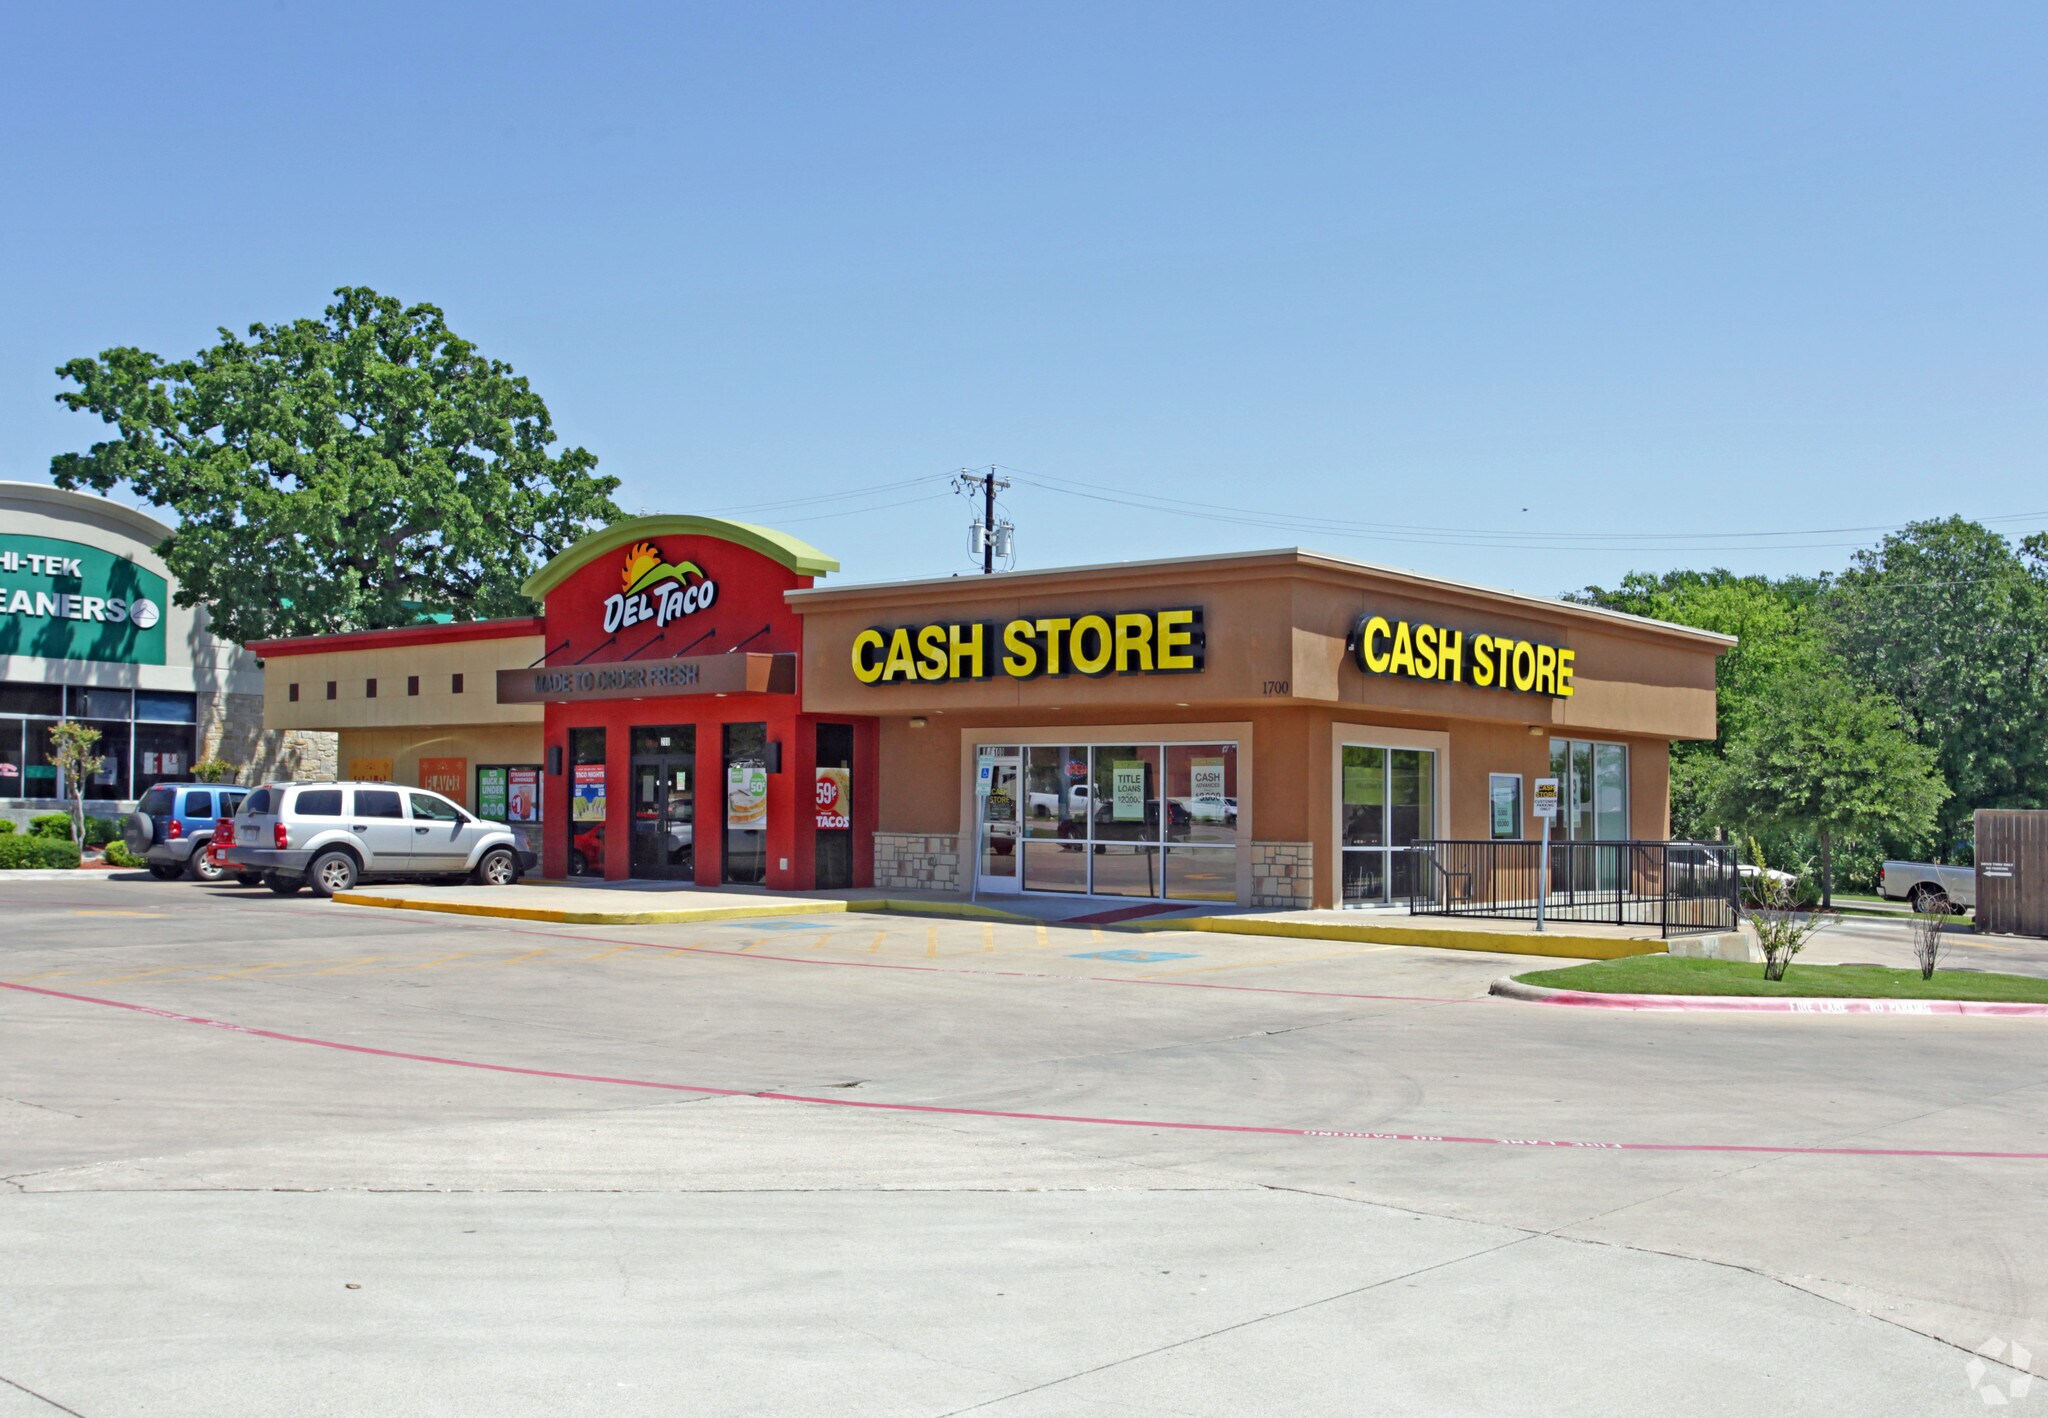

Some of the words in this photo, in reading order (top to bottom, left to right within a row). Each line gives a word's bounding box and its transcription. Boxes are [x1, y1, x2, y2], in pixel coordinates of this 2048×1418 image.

[603, 593, 654, 633] DEL
[653, 581, 714, 627] TACO
[851, 623, 984, 684] CASH
[1002, 610, 1194, 677] STORE
[1363, 615, 1463, 682] CASH
[1472, 633, 1576, 697] STORE
[534, 672, 572, 692] MADE
[575, 671, 594, 691] TO
[595, 668, 646, 690] ORDER
[649, 664, 699, 687] FRESH
[1262, 680, 1289, 695] 1700
[1117, 774, 1141, 784] TITLE
[1195, 772, 1221, 782] CASH
[482, 785, 505, 794] UNDER
[816, 782, 837, 804] 59¢
[1117, 785, 1141, 793] LOANS
[989, 796, 1010, 804] STORE
[816, 816, 850, 828] TACOS
